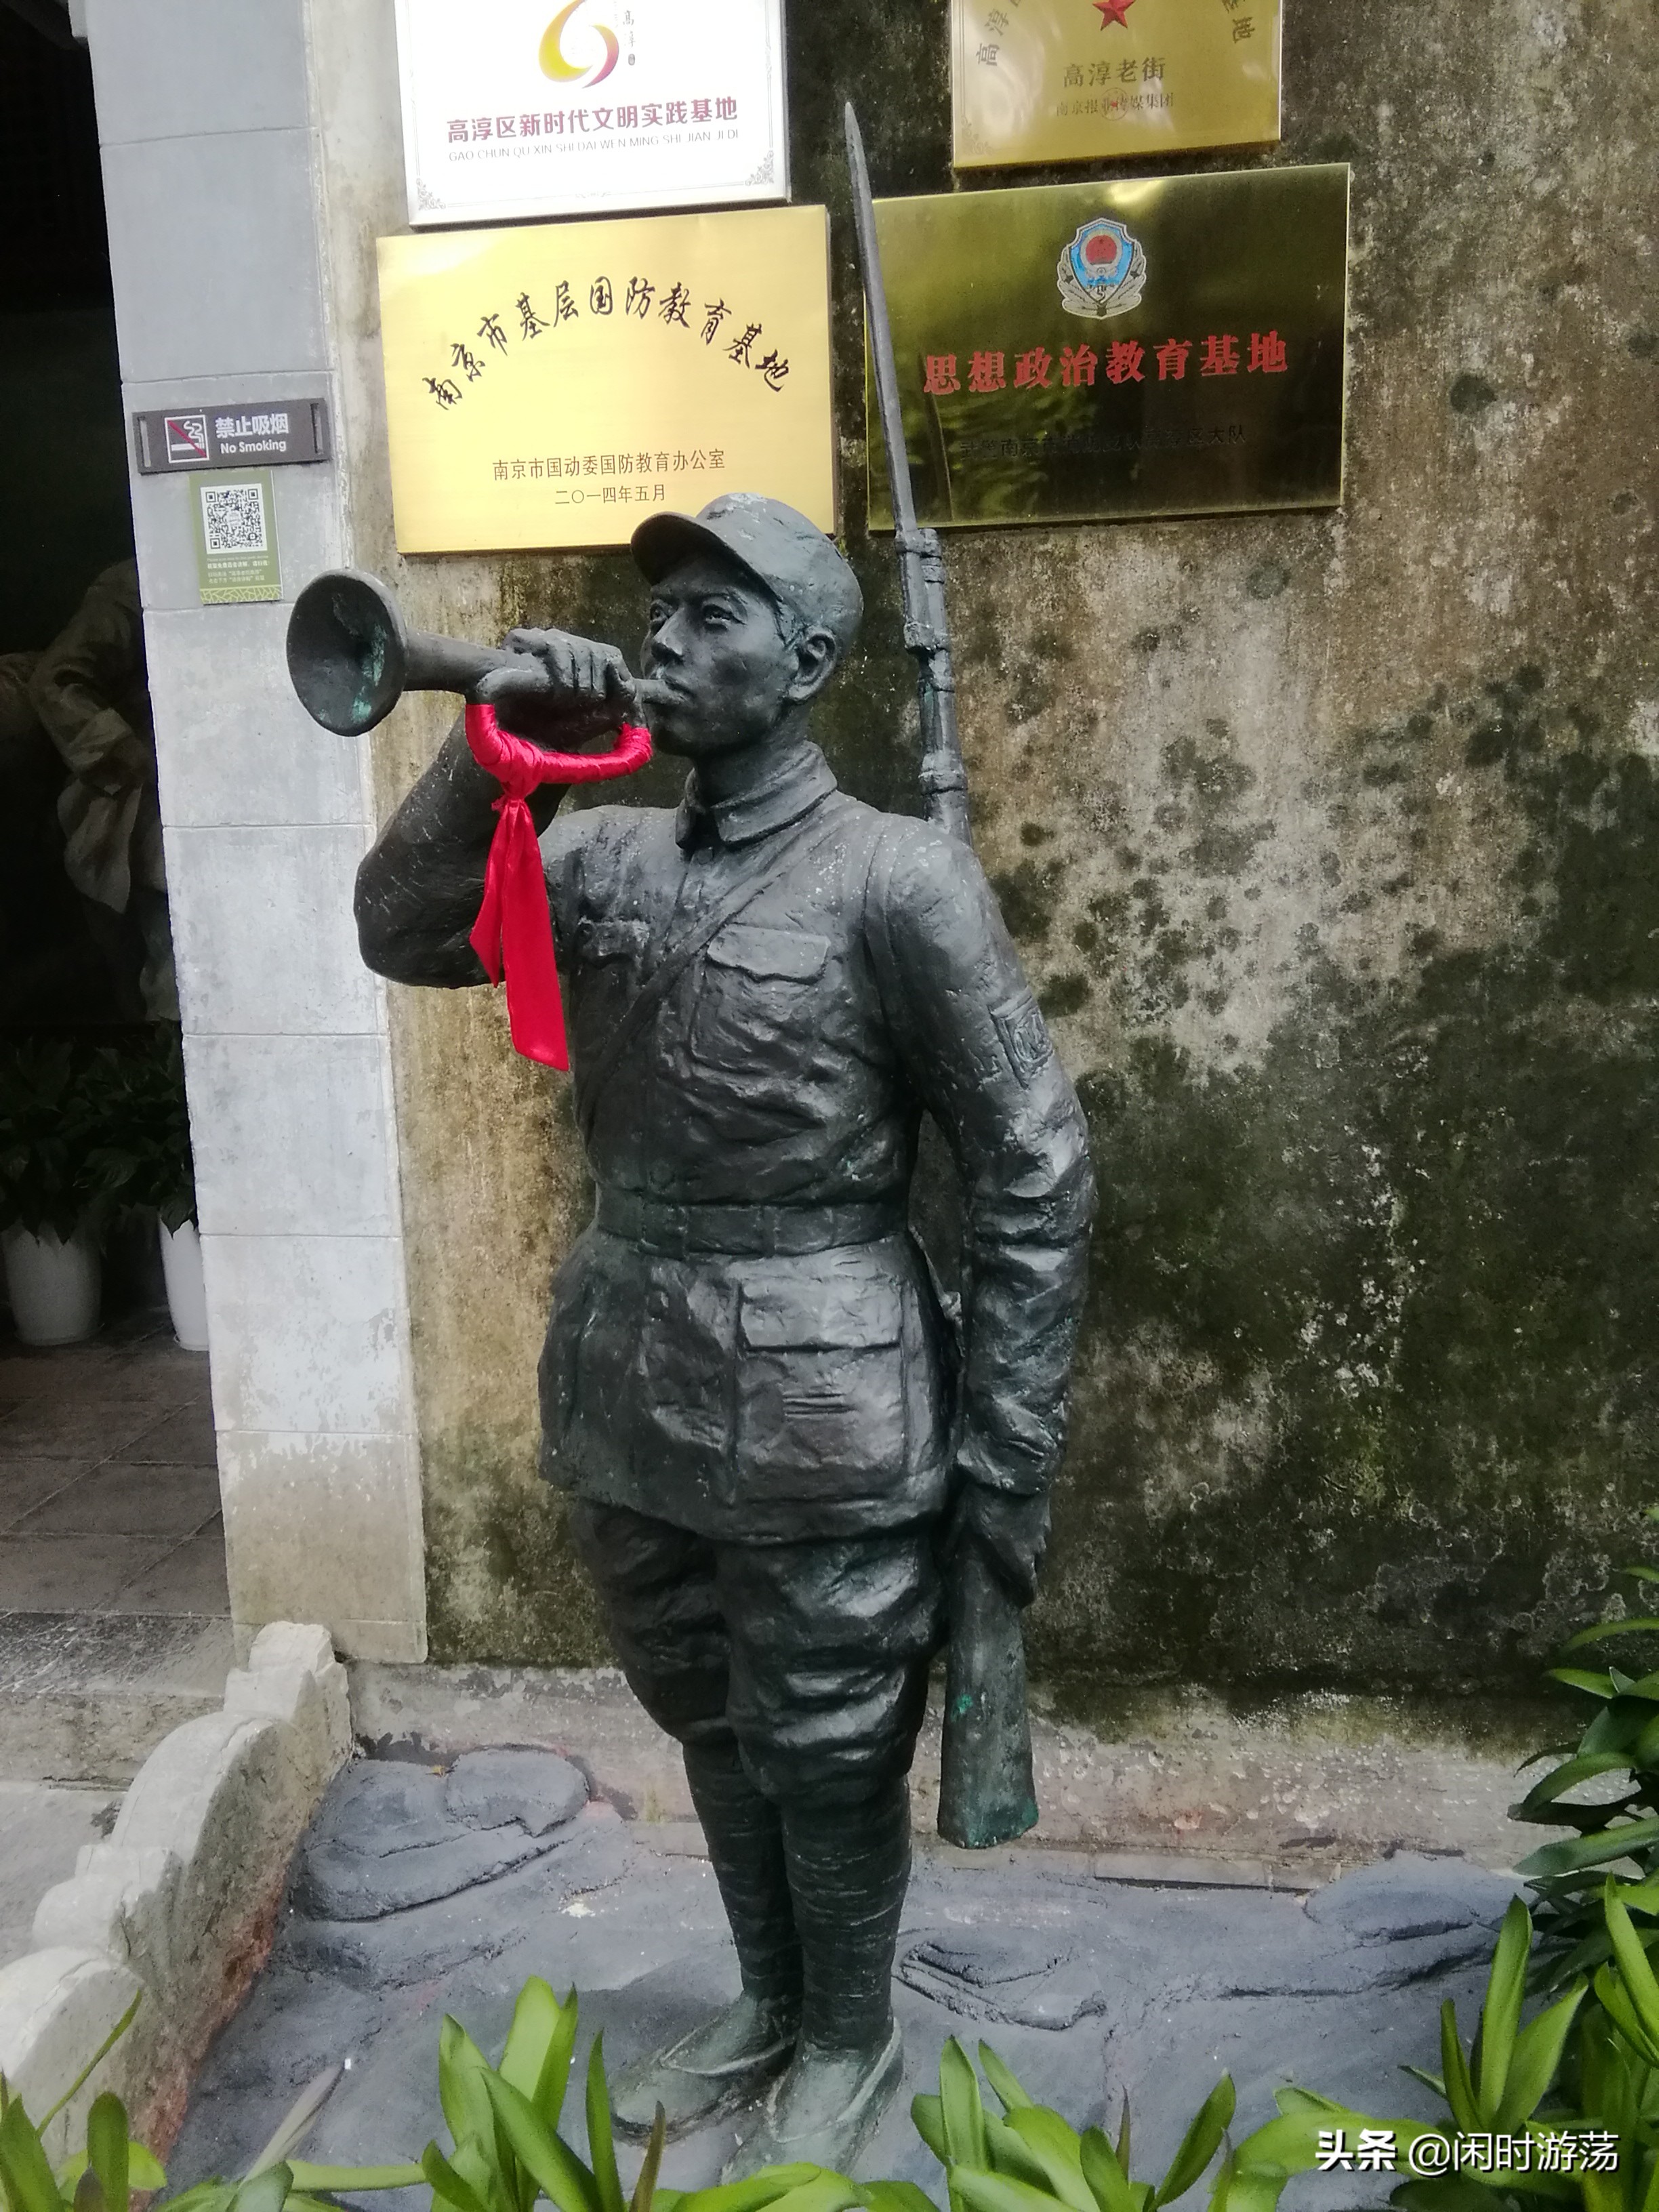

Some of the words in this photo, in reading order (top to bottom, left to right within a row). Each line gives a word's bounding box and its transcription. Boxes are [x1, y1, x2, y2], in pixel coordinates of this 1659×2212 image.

[1062, 56, 1166, 88] 高淳老街
[447, 96, 738, 143] 高淳区新时代文明实践基地
[449, 150, 474, 161] GAO
[478, 148, 510, 159] CHUN
[512, 146, 531, 159] QU
[533, 144, 552, 156] XIN
[556, 143, 575, 152] SHI
[577, 140, 597, 152] DAI
[600, 139, 626, 149] WEN
[630, 136, 659, 147] MING
[663, 135, 681, 144] SHI
[687, 132, 711, 142] JIAN
[716, 131, 724, 140] JI
[728, 129, 739, 140] DI
[422, 275, 792, 411] 南京市基层国防教育基地
[922, 330, 1289, 395] 思想政治教育基地
[215, 413, 289, 438] 禁止吸烟
[220, 443, 237, 454] No
[239, 439, 287, 453] Smoking
[492, 448, 726, 481] 南京市国动委国防教育办公室
